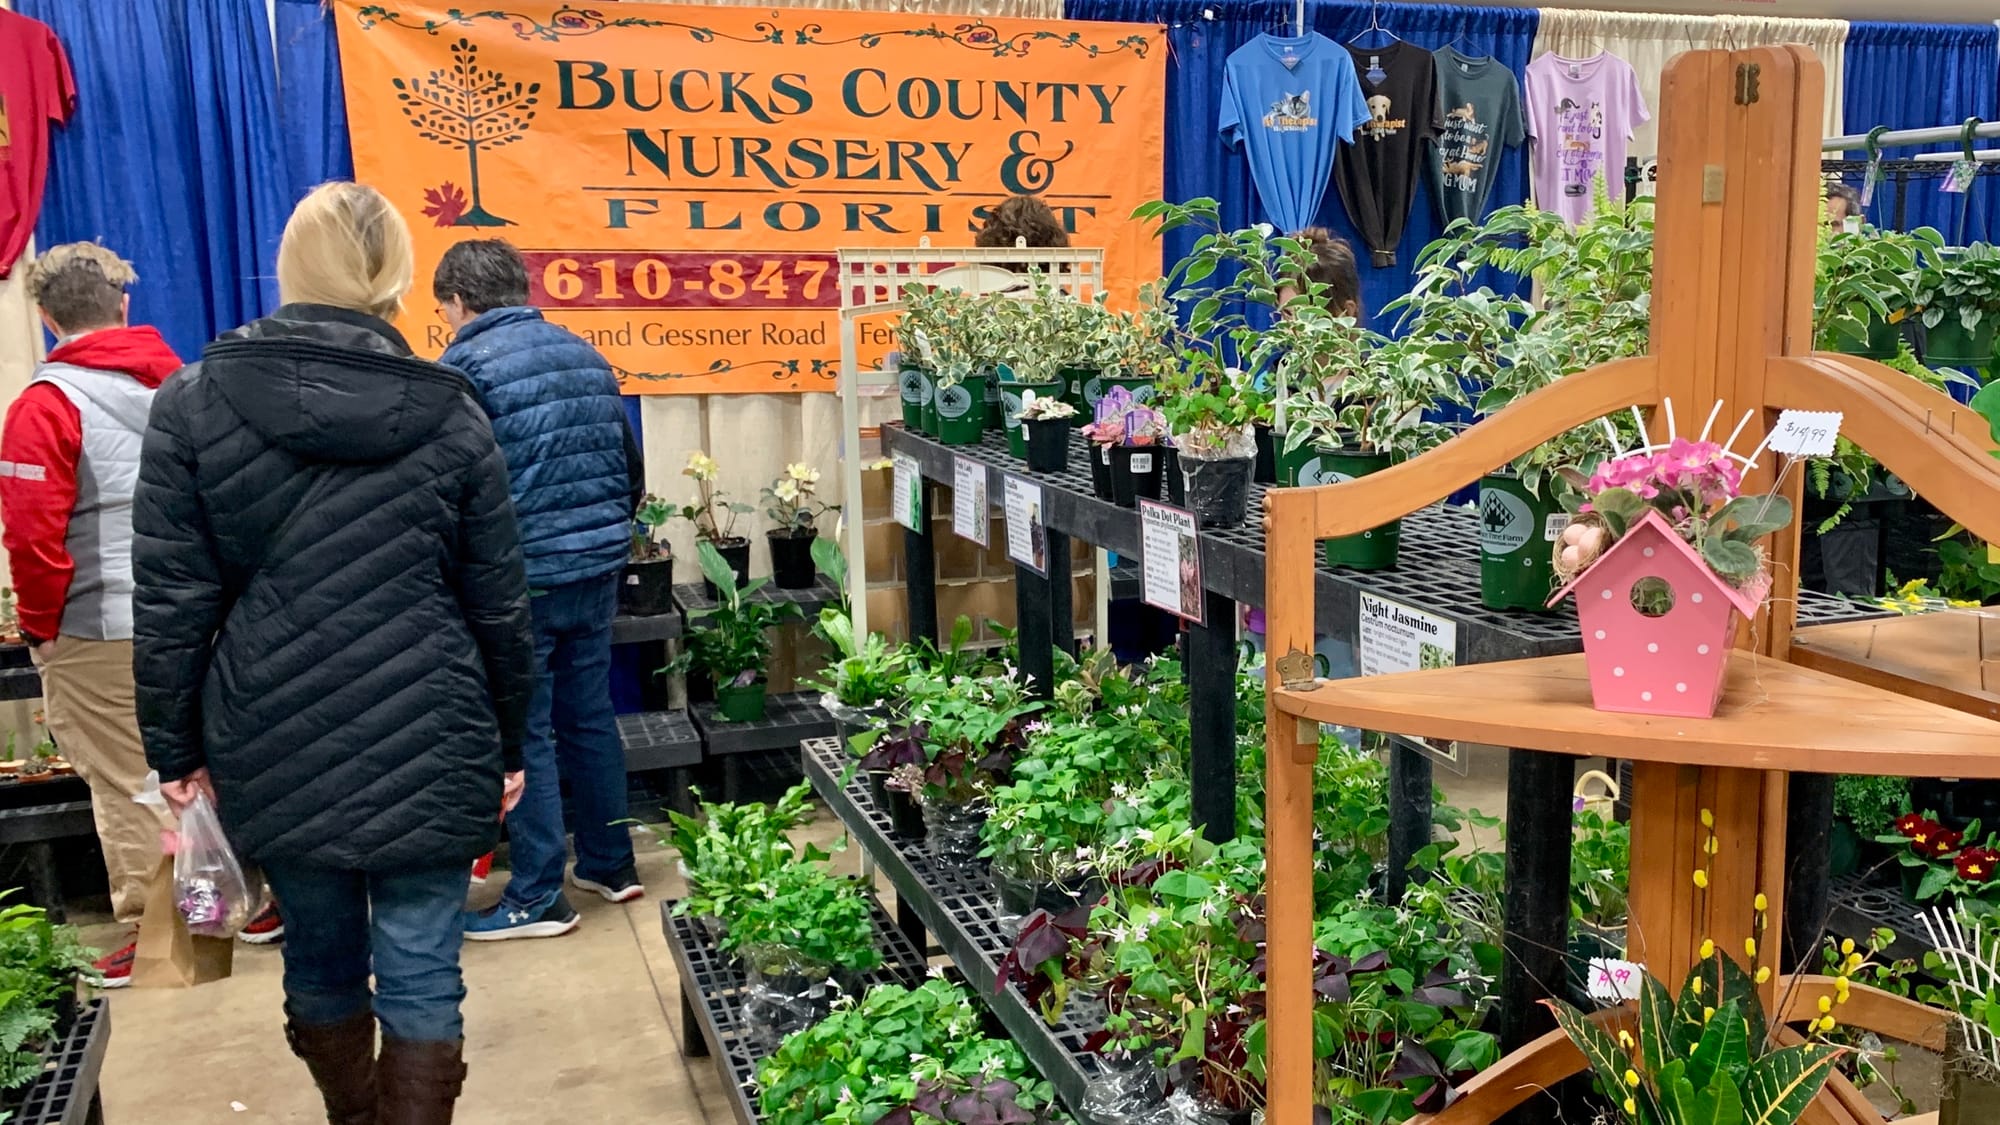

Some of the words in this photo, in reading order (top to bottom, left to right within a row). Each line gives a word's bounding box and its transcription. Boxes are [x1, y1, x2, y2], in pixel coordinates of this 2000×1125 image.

[553, 60, 814, 125] BUCKS
[841, 67, 1128, 125] COUNTY
[622, 128, 973, 192] NURSERY
[1000, 130, 1074, 195] &
[583, 322, 632, 347] and
[641, 322, 755, 347] Gessner
[762, 321, 826, 346] Road
[1142, 504, 1160, 519] Polka
[1161, 510, 1173, 523] Dot
[1173, 512, 1191, 528] Plant
[1502, 533, 1524, 543] Farm
[1362, 596, 1389, 619] Night
[1392, 607, 1438, 636] Jasmine
